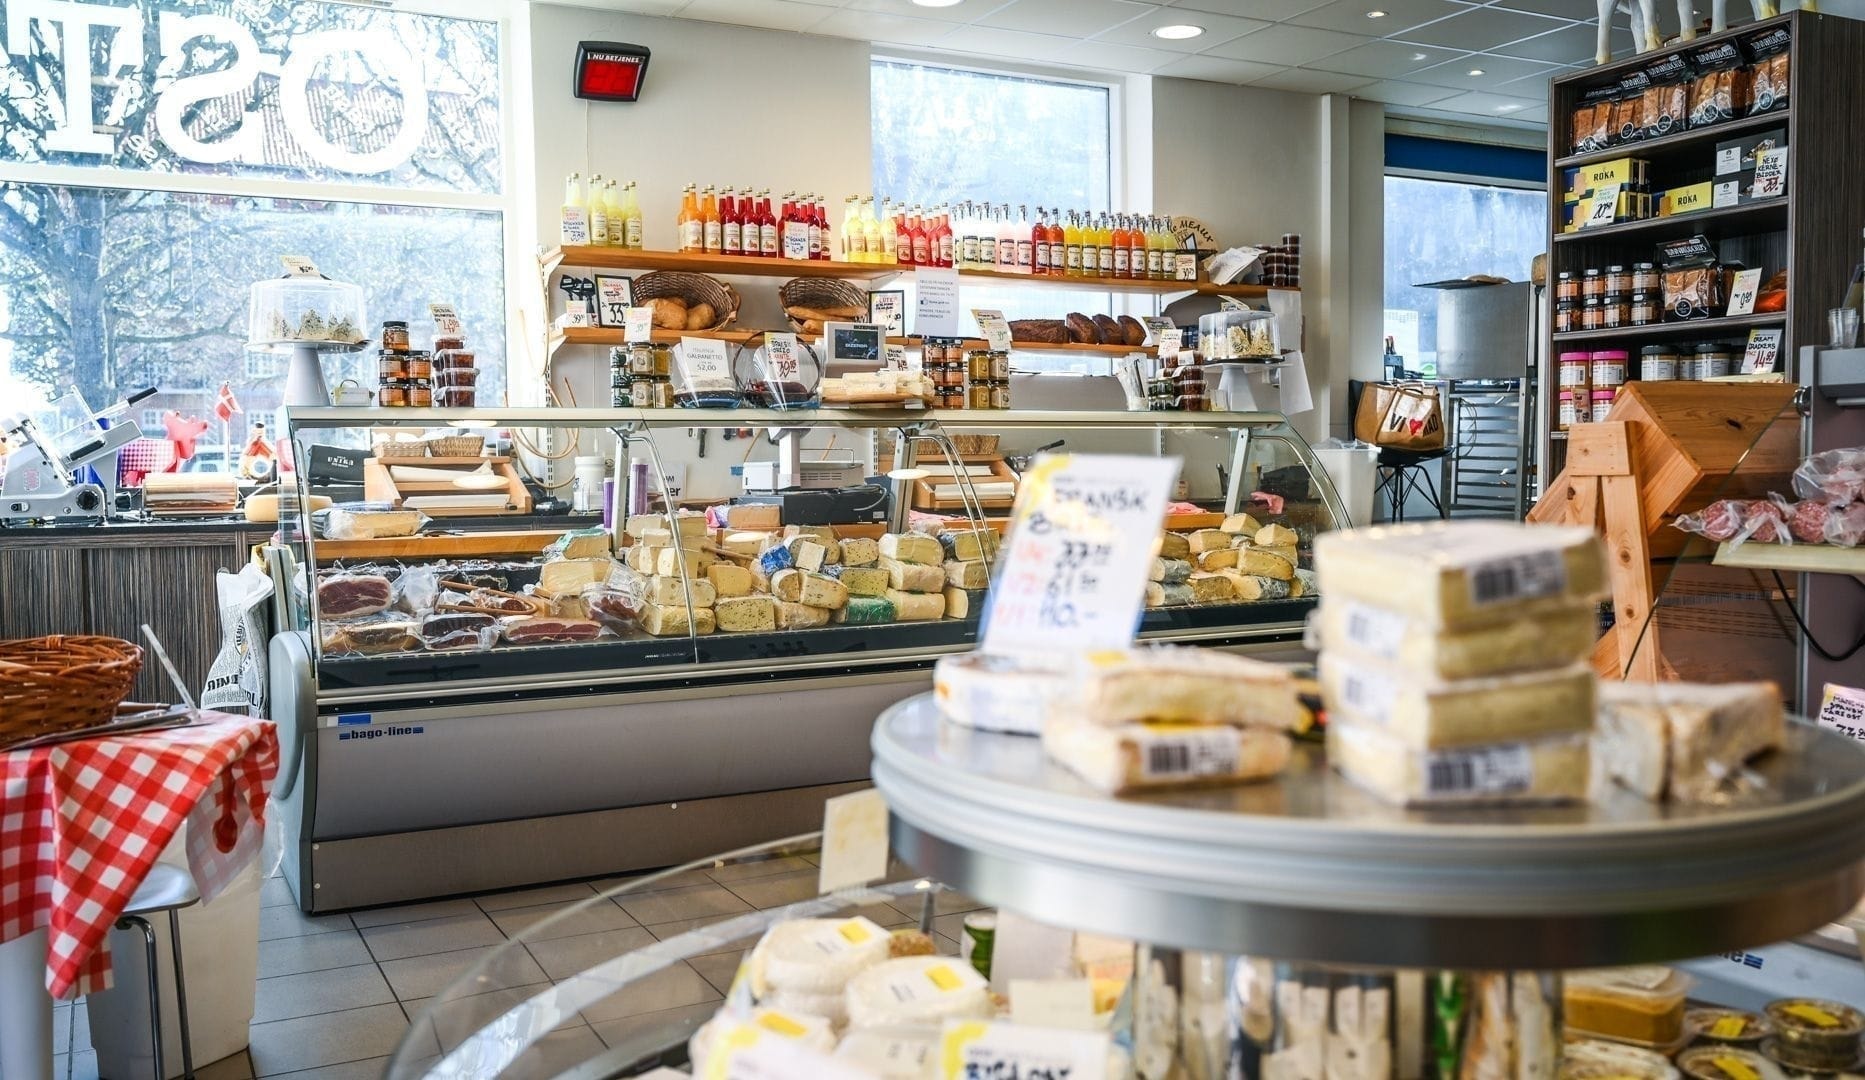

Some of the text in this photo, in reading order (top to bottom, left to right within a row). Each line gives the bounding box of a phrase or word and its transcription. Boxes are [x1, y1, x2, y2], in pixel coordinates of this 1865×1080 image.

[1593, 170, 1615, 181] ROKA
[1677, 195, 1698, 205] ROKA
[1179, 220, 1214, 242] MEAUX
[351, 726, 412, 740] bago-line
